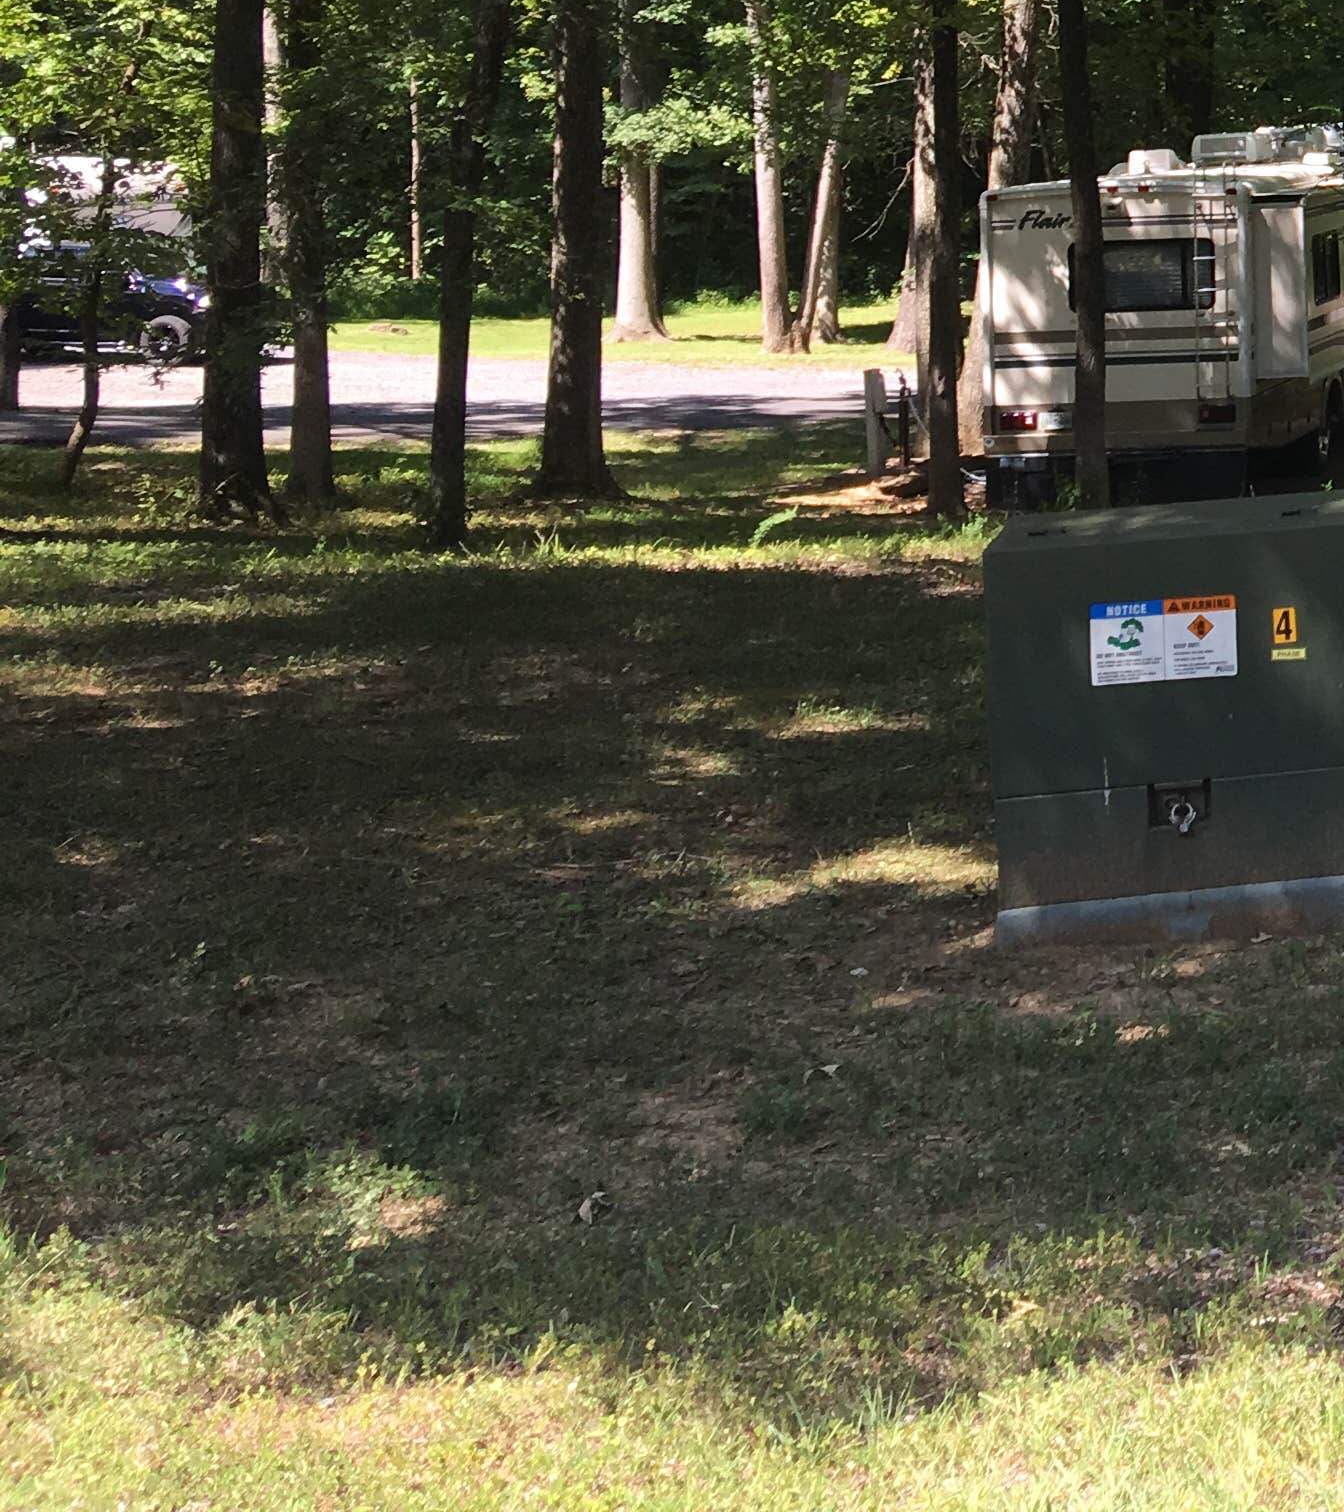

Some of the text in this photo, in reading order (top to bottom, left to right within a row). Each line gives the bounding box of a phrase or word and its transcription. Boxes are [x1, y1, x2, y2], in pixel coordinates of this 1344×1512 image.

[1018, 209, 1072, 230] Flair
[1106, 603, 1147, 617] NOTICE
[1181, 598, 1231, 610] WARNING
[1276, 610, 1292, 640] 4
